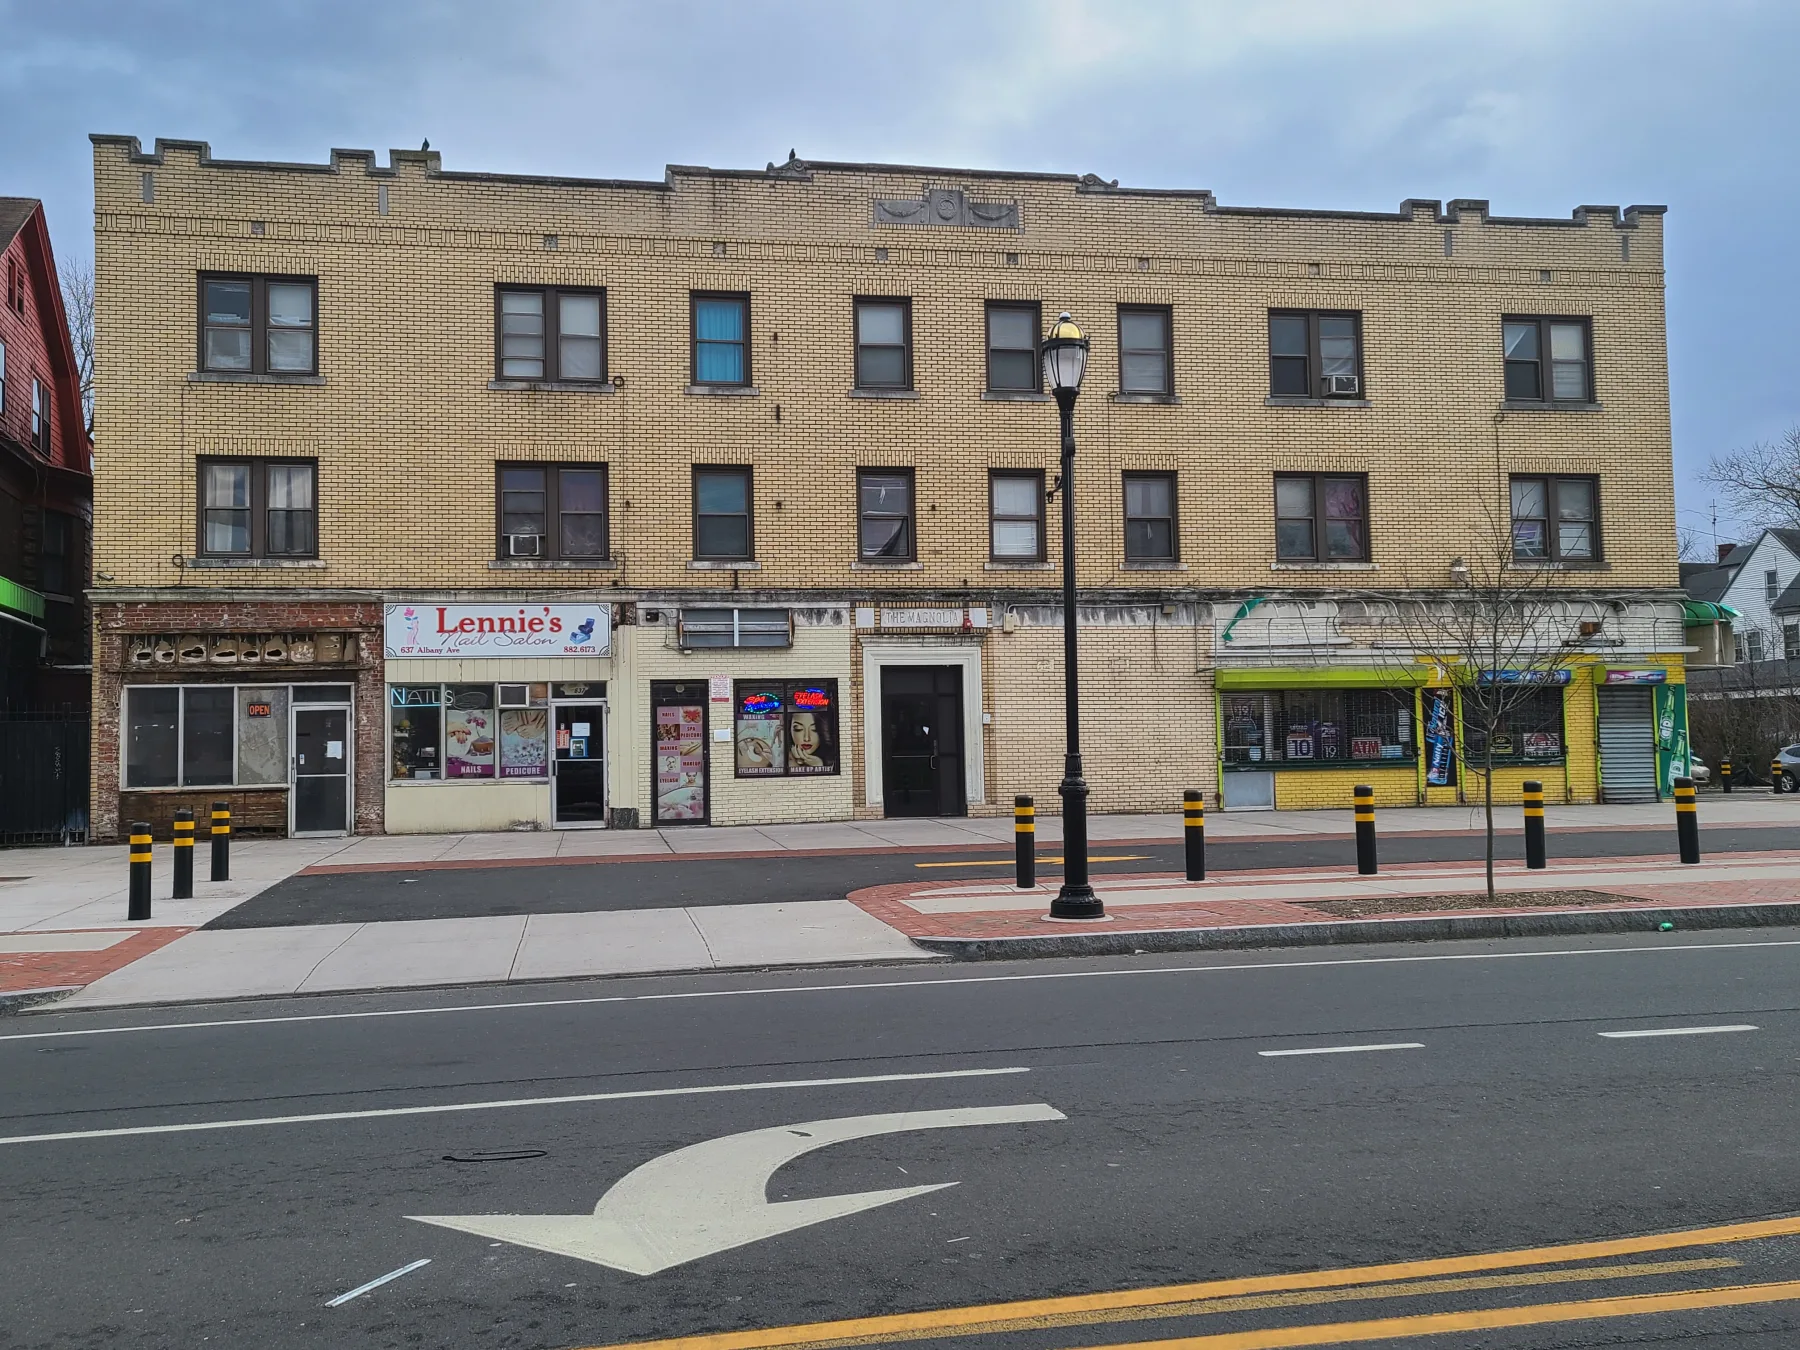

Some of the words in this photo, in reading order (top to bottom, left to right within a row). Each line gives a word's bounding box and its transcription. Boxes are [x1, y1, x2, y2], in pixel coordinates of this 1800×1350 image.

[436, 607, 562, 633] Lennie's
[886, 611, 905, 624] THE
[907, 611, 958, 624] MAGNOLIA
[439, 631, 489, 647] Nail
[494, 629, 558, 647] Salon
[417, 646, 443, 655] Albany
[249, 705, 270, 715] OPEN
[1354, 741, 1379, 753] ATM
[460, 765, 482, 774] NAILS
[505, 767, 541, 776] PEDICURE
[790, 765, 805, 773] MAKE
